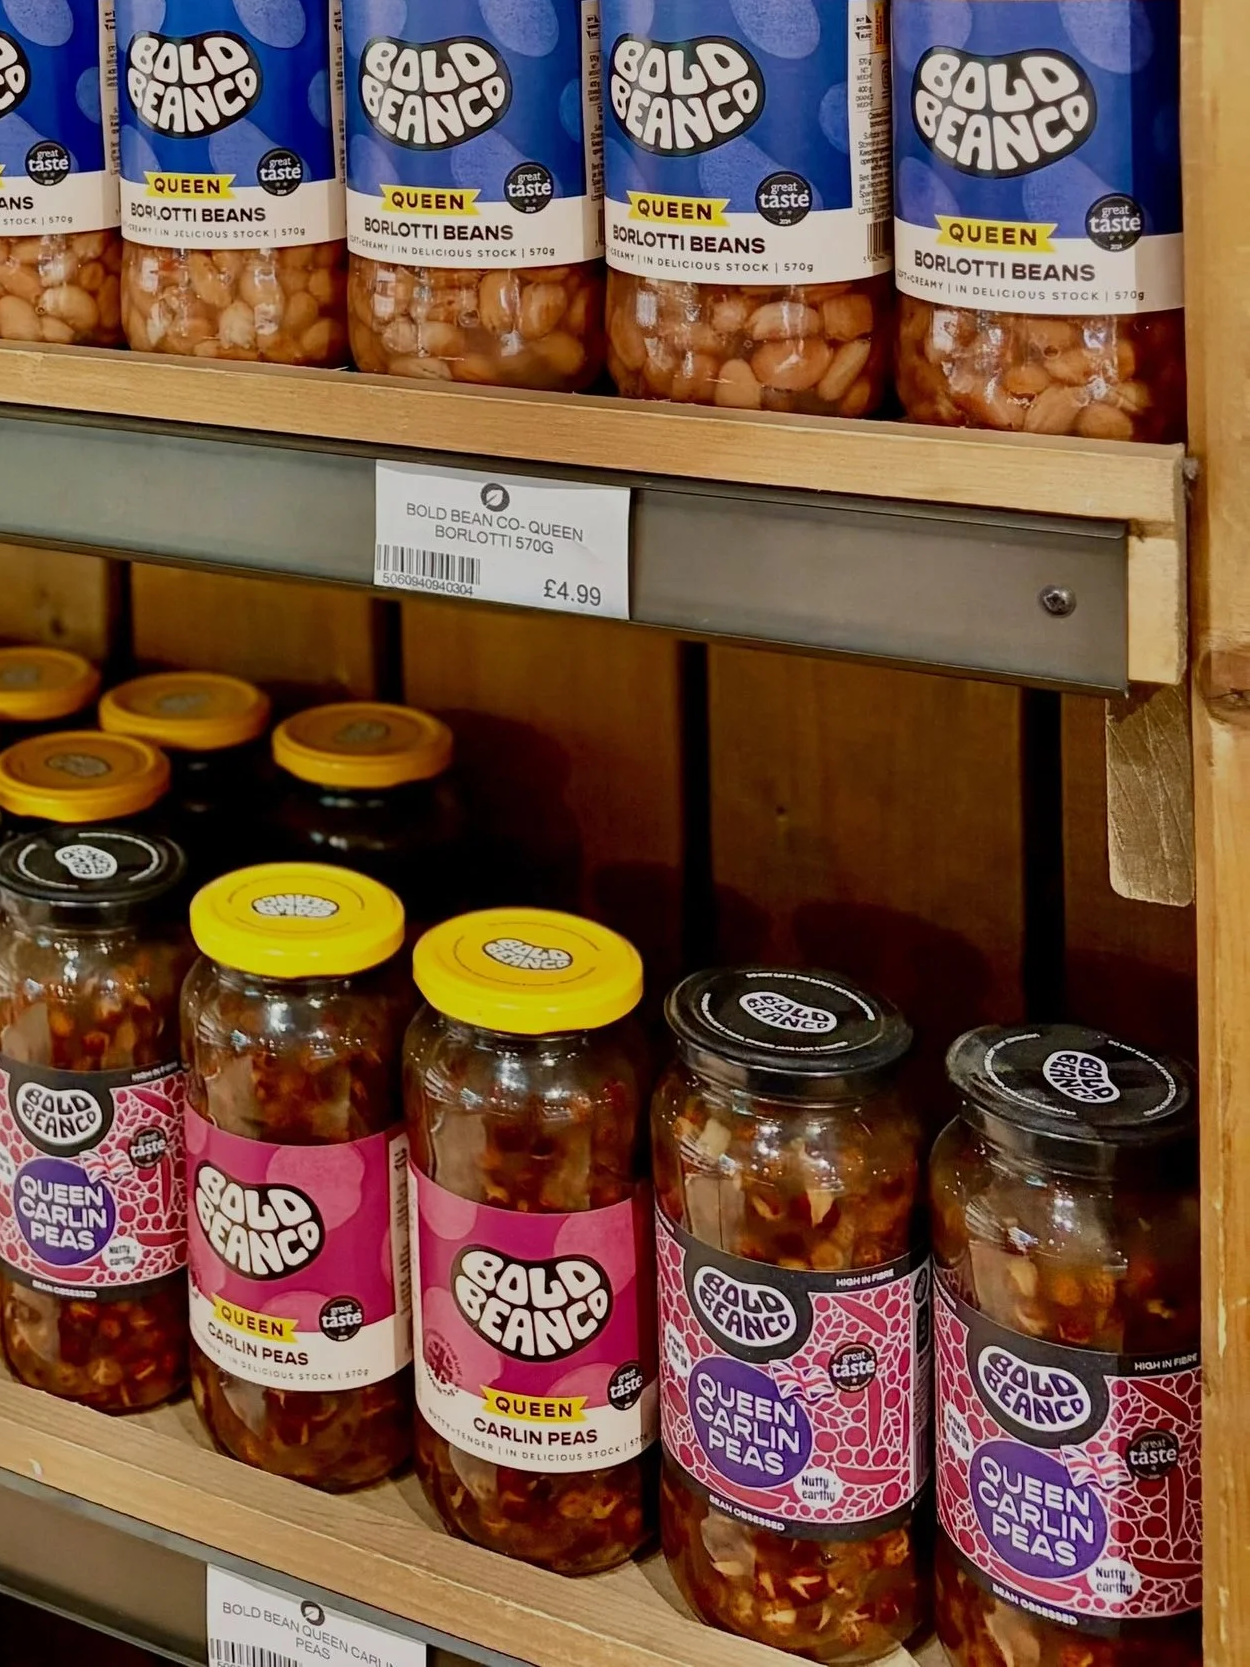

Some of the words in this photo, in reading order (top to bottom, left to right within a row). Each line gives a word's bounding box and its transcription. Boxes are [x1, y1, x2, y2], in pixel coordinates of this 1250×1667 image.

[365, 41, 498, 93] BOLD
[614, 40, 749, 96] BOLD
[920, 53, 1080, 113] BOLD
[153, 177, 221, 194] QUEEN
[391, 191, 465, 210] QUEEN
[637, 198, 712, 221] QUEEN
[758, 191, 810, 209] taste
[1101, 204, 1130, 219] great
[201, 207, 267, 222] BEANS
[1089, 215, 1141, 234] taste
[443, 224, 514, 241] BEANS
[690, 236, 766, 255] BEANS
[948, 222, 1037, 247] QUEEN
[914, 249, 1005, 280] BORLOTTI
[1011, 263, 1096, 282] BEANS
[955, 284, 968, 294] IN
[972, 286, 1046, 301] DELICIOUS
[1051, 290, 1099, 301] STOCK
[1114, 290, 1145, 301] 570g
[406, 502, 447, 521] BOLD
[451, 509, 493, 527] BEAN
[496, 515, 526, 531] CO-
[529, 520, 584, 542] QUEEN
[435, 524, 512, 549] BORLOTTI
[516, 537, 554, 555] 570G
[382, 572, 473, 597] 5060940940304
[543, 578, 601, 607] £4.99
[461, 1249, 601, 1309] BOLD
[836, 1276, 860, 1287] HIGH
[861, 1275, 870, 1284] IN
[872, 1269, 894, 1282] FIBRE
[702, 1272, 785, 1314] BOLD
[830, 1359, 877, 1378] taste
[495, 1396, 573, 1418] QUEEN
[696, 1372, 796, 1427] QUEEN
[473, 1417, 543, 1445] CARLIN
[548, 1428, 598, 1446] PEAS
[694, 1396, 800, 1454] CARLIN
[707, 1429, 785, 1476] PEAS
[1129, 1447, 1177, 1466] taste
[801, 1475, 829, 1490] Nutty
[801, 1489, 835, 1502] earthy
[979, 1455, 1090, 1517] QUEEN
[709, 1494, 733, 1514] BEAN
[733, 1507, 785, 1532] OBSESSED
[977, 1479, 1094, 1545] CARLIN
[991, 1516, 1077, 1567] PEAS
[222, 1602, 261, 1619] BOLD
[263, 1610, 300, 1633] BEAN
[301, 1624, 349, 1654] QUEEN
[295, 1637, 331, 1660] PEAS
